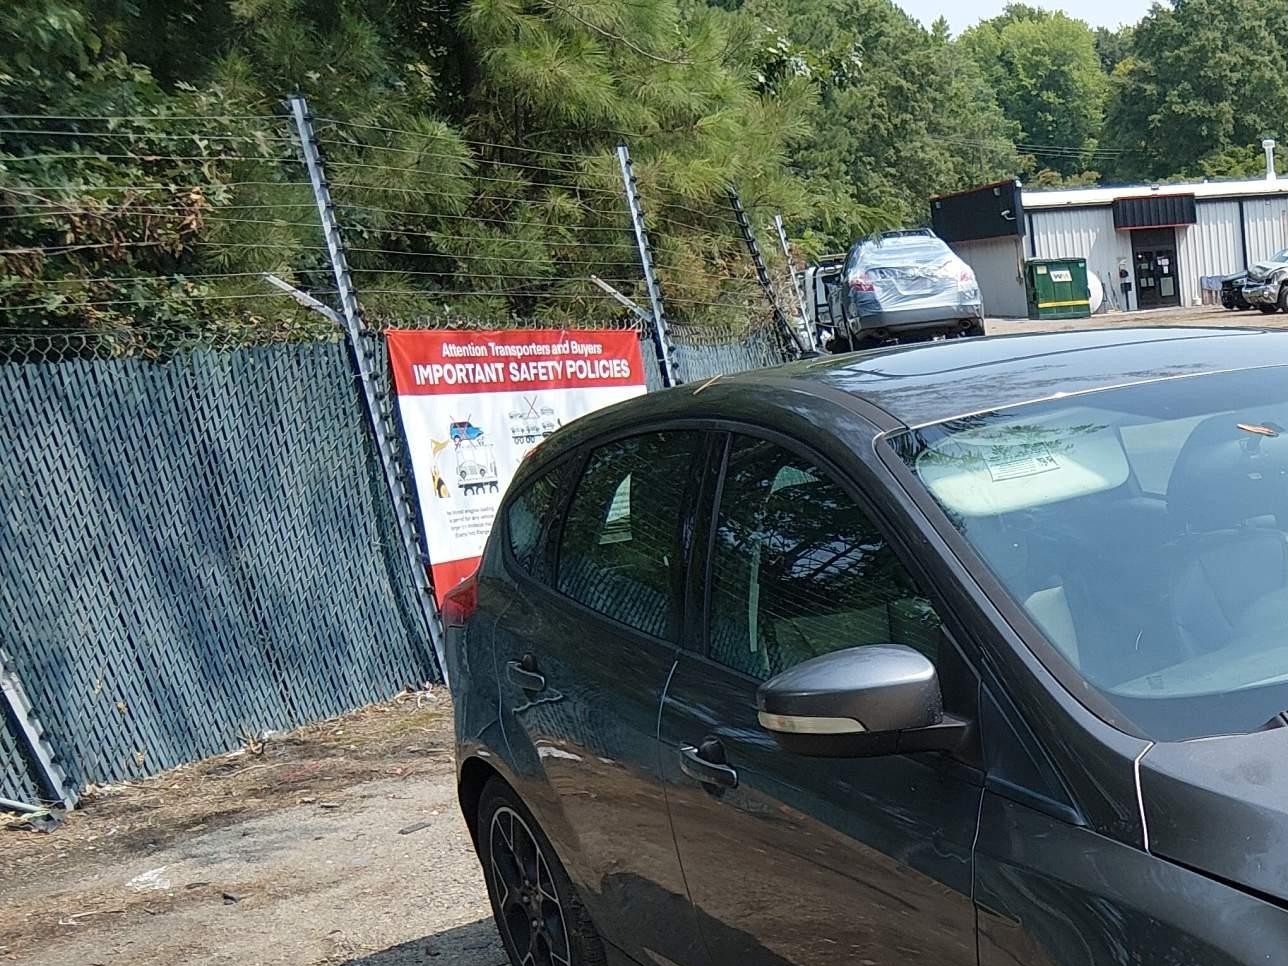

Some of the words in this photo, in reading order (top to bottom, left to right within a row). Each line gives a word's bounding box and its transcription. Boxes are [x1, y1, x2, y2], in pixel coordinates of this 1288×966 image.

[442, 342, 488, 357] Attention
[488, 342, 550, 359] Transporters
[552, 341, 570, 354] and
[571, 341, 602, 357] Buyers
[413, 362, 505, 385] IMPORTANT
[509, 360, 563, 382] SAFETY
[566, 359, 631, 379] POLICIES
